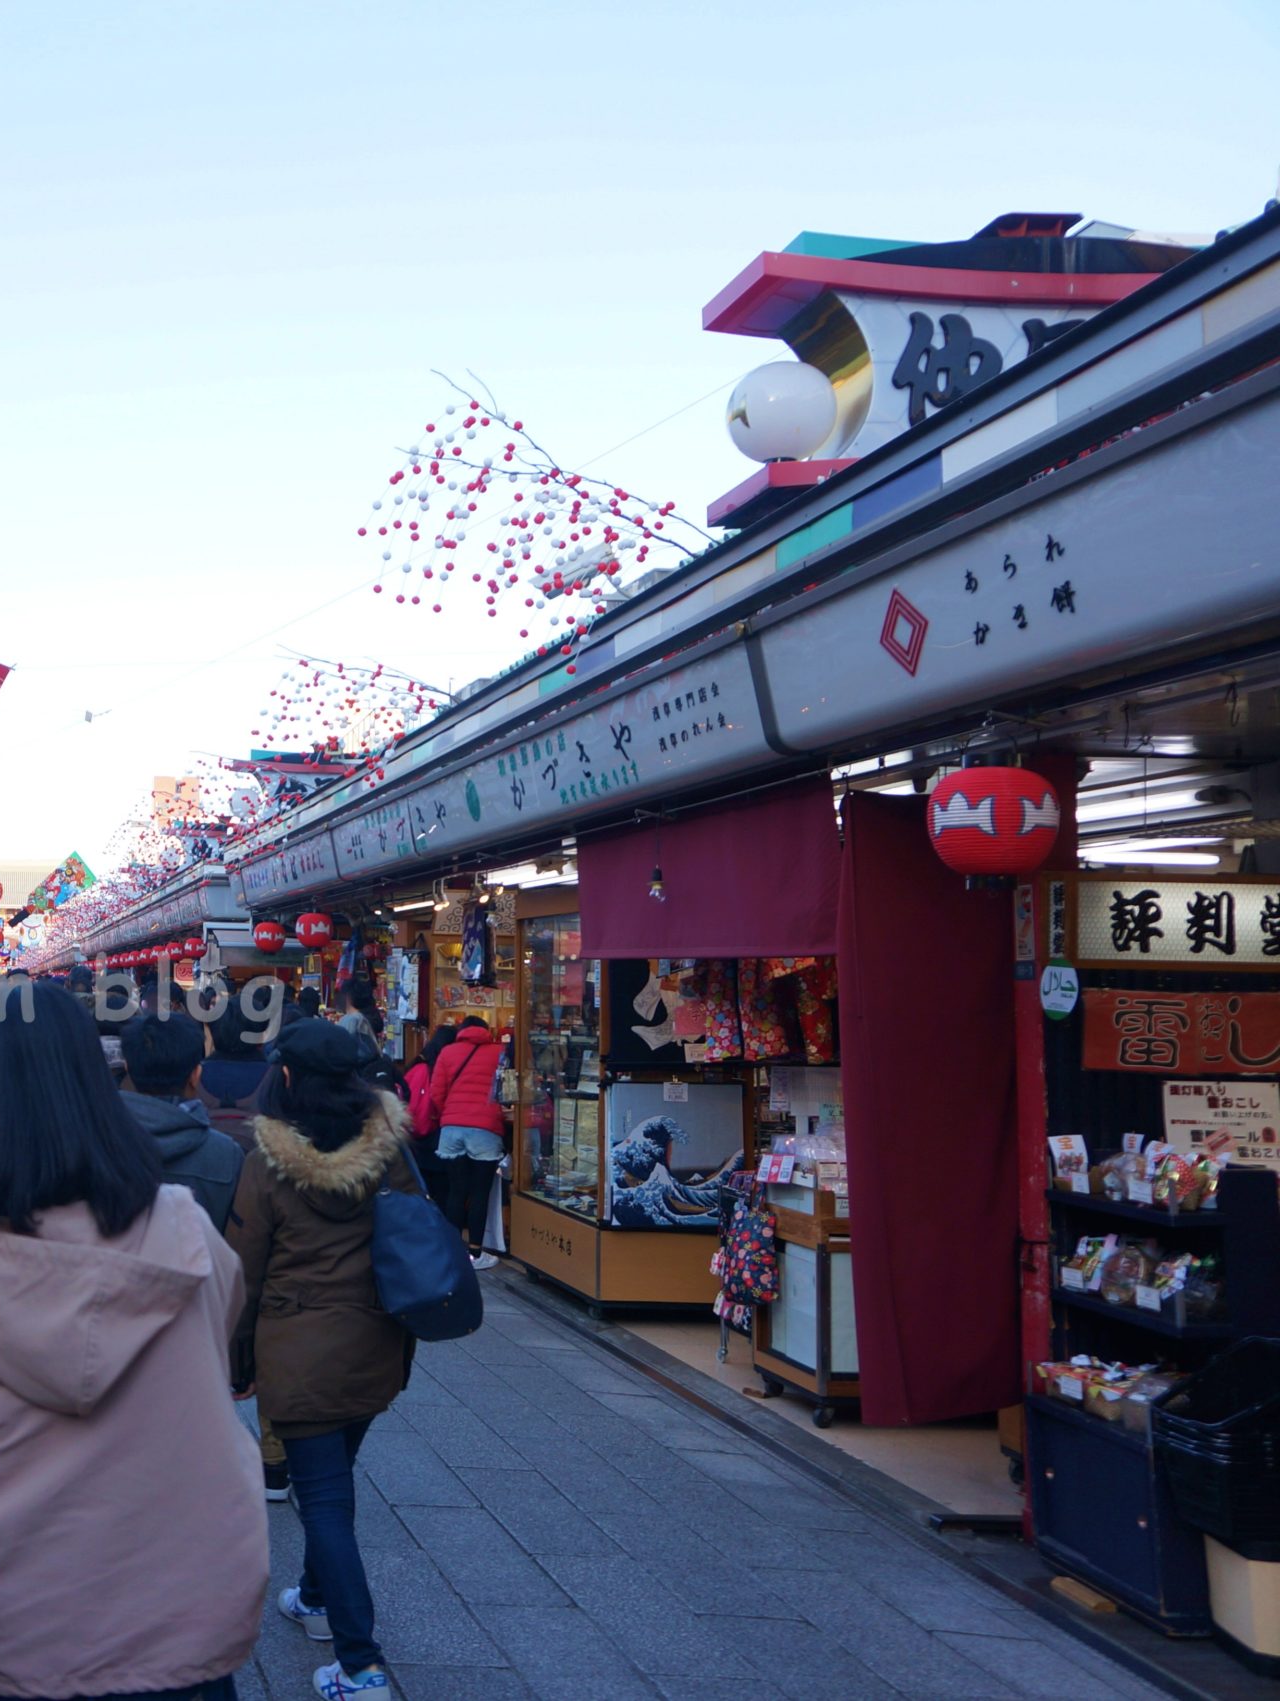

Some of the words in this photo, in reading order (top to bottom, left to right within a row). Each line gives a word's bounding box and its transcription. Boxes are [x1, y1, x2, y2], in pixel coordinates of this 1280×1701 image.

[964, 533, 1066, 594] あられ
[658, 711, 727, 752] 浅草のれん会
